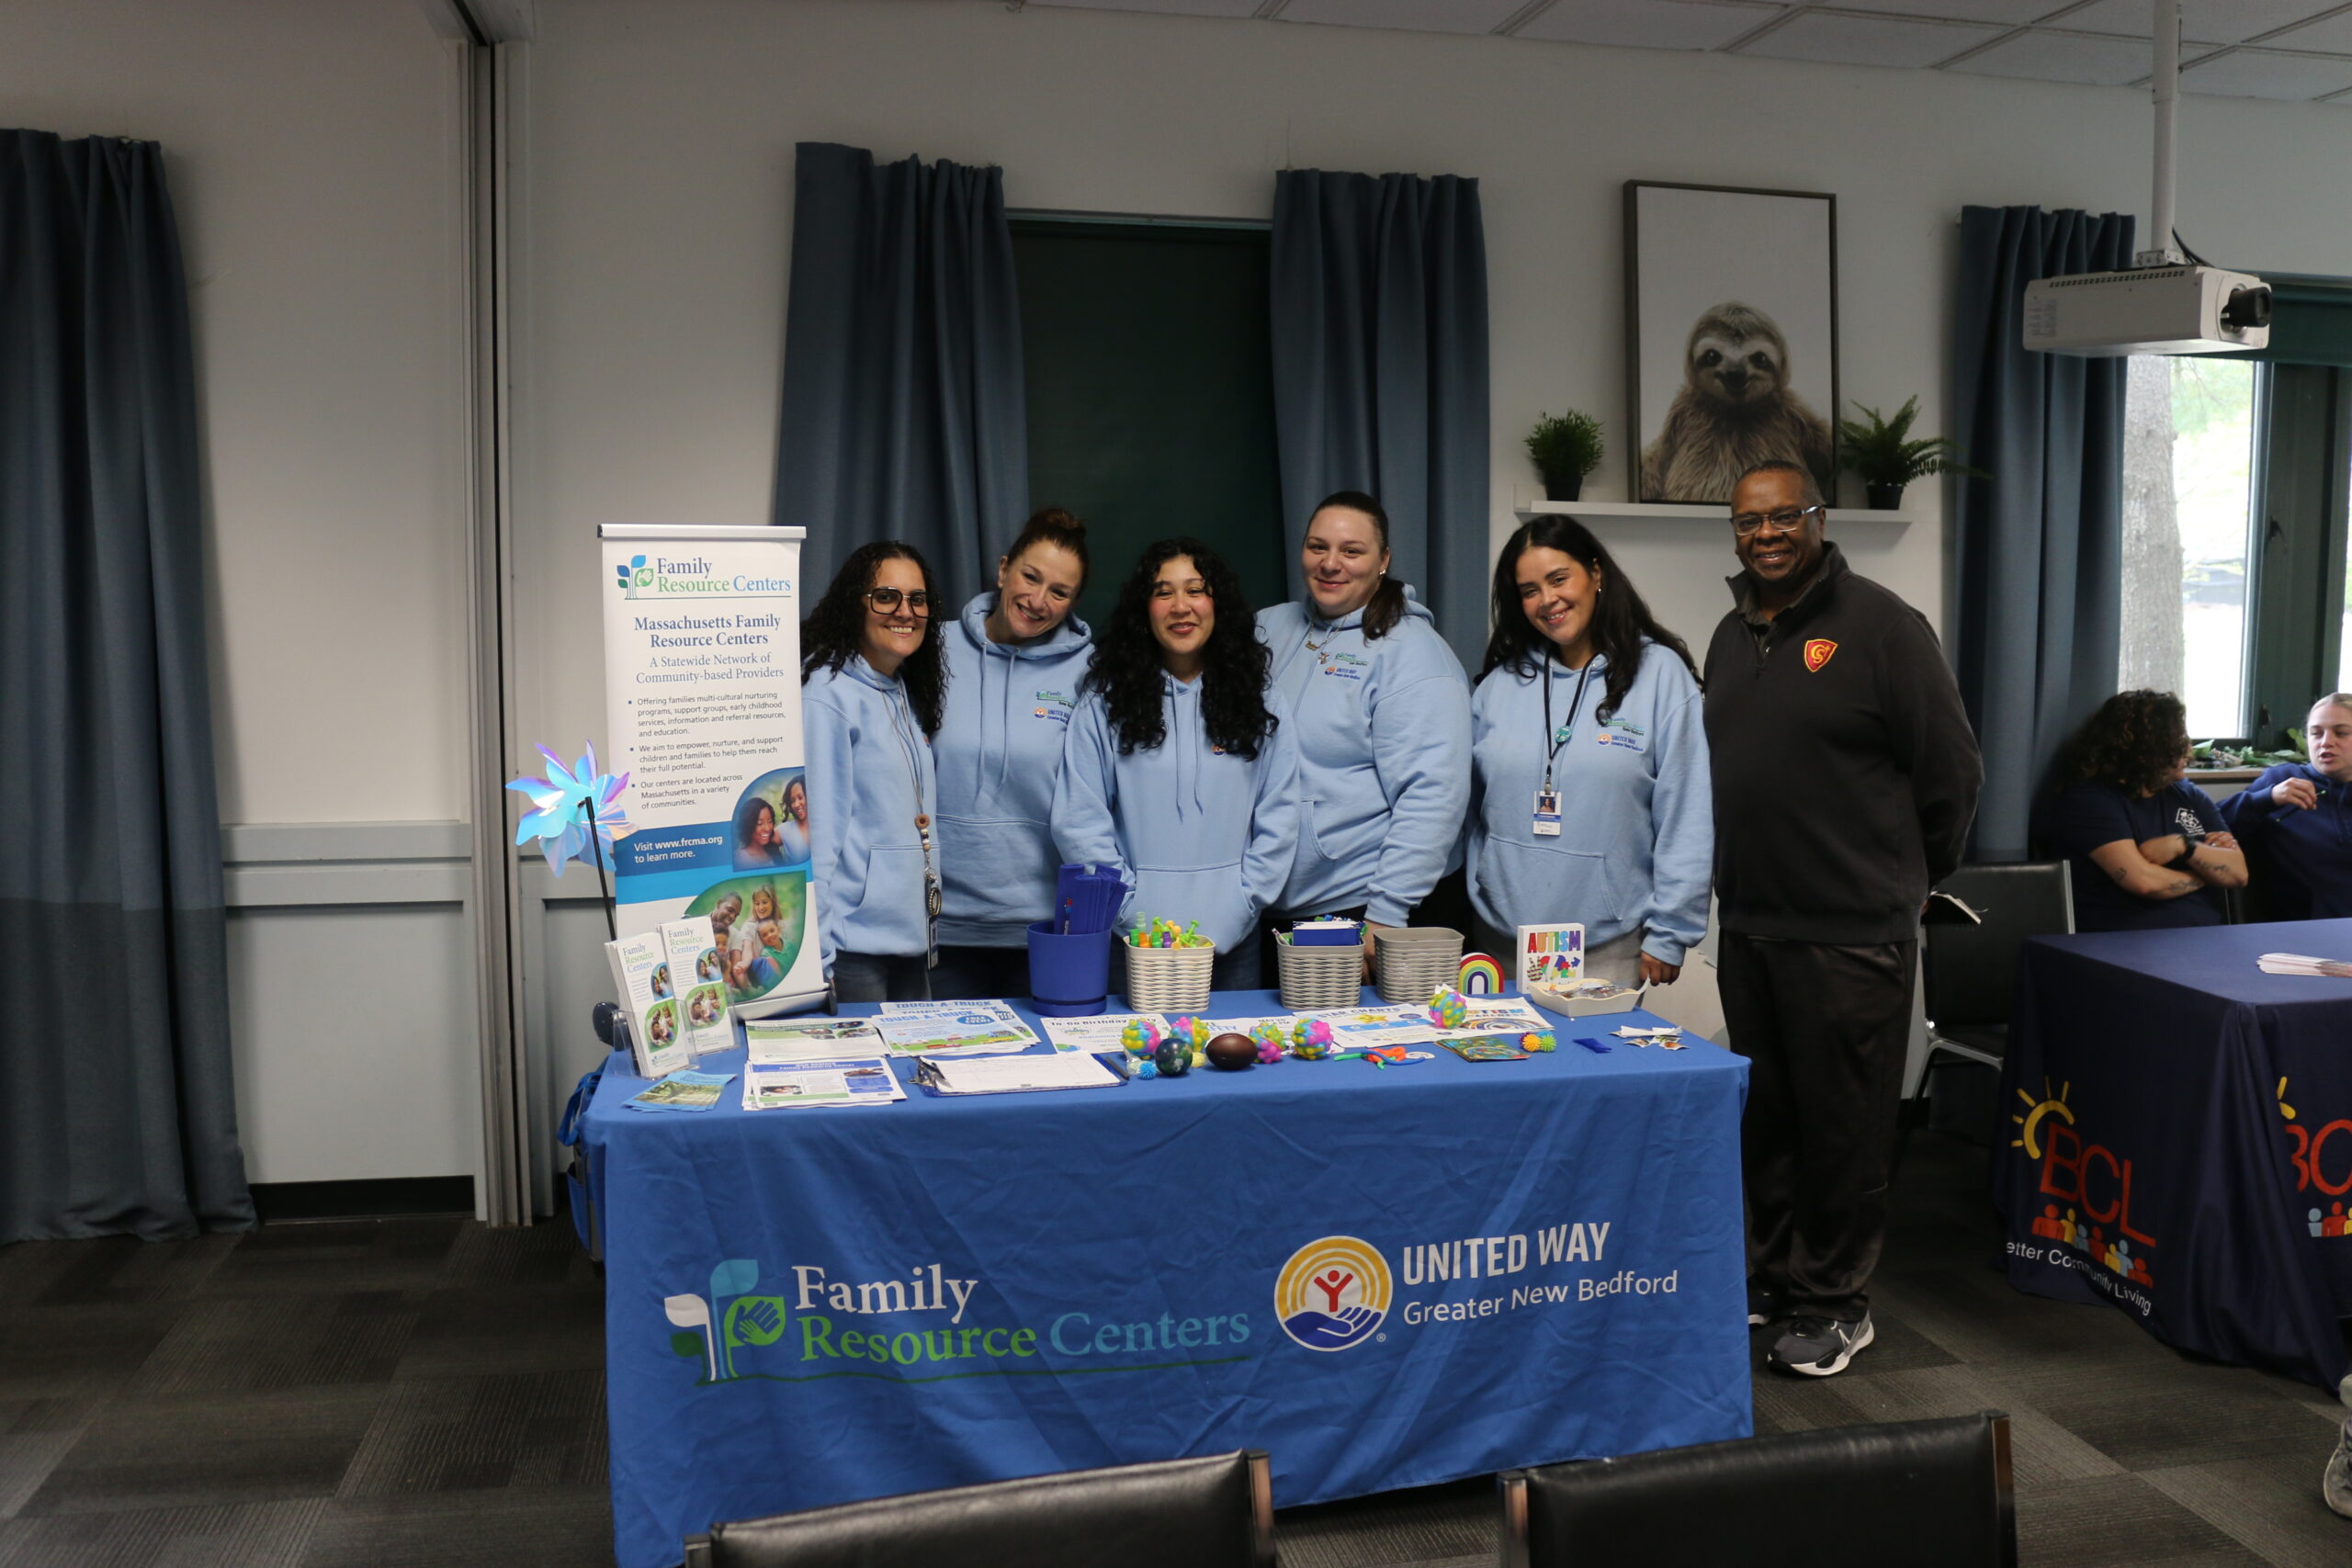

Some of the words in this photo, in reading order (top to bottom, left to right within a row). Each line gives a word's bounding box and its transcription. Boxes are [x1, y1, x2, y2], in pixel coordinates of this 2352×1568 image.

[657, 558, 712, 578] Family
[658, 577, 729, 592] Resource
[733, 576, 791, 592] Centers
[634, 615, 731, 630] Massachusetts
[736, 614, 781, 630] Family
[650, 635, 712, 648] Resource
[717, 632, 768, 646] Centers
[650, 657, 658, 668] A
[661, 655, 710, 667] Statewide
[714, 653, 757, 665] Network
[761, 652, 772, 663] of
[636, 671, 733, 683] Community-based
[736, 668, 784, 680] Providers
[638, 697, 666, 705] Offering
[697, 694, 742, 703] multi-cultural
[638, 708, 672, 717] programs,
[674, 706, 701, 715] support
[703, 705, 728, 714] groups,
[639, 718, 666, 727] services,
[668, 716, 709, 725] information
[653, 728, 690, 736] education.
[676, 741, 711, 750] empower,
[741, 737, 754, 745] and
[757, 736, 783, 745] support
[639, 754, 667, 762] children
[670, 752, 682, 761] and
[684, 750, 711, 759] families
[722, 749, 737, 758] help
[759, 746, 777, 754] reach
[640, 765, 656, 773] their
[672, 761, 706, 772] potential.
[641, 781, 654, 789] Our
[656, 778, 680, 787] centers
[682, 777, 694, 785] are
[695, 774, 721, 784] located
[723, 773, 742, 782] across
[641, 788, 690, 799] Massachusetts
[692, 786, 698, 795] in
[707, 785, 729, 795] variety
[642, 801, 649, 809] of
[650, 798, 696, 808] communities.
[634, 841, 653, 852] Visit
[655, 836, 723, 850] www.frcma.org
[635, 854, 644, 863] to
[647, 851, 668, 863] learn
[670, 849, 695, 859] more.
[668, 928, 694, 938] Family
[623, 943, 646, 955] Family
[670, 937, 704, 946] Resource
[1527, 931, 1580, 953] AUTISM
[671, 945, 700, 954] Centers
[628, 962, 652, 973] Centers
[2039, 1121, 2156, 1248] BCL
[1403, 1234, 1527, 1286] UNITED
[1538, 1222, 1611, 1266] WAY
[2007, 1242, 2043, 1260] etter
[2115, 1283, 2152, 1316] Living
[792, 1264, 978, 1324] Family
[1404, 1294, 1503, 1325] Greater
[1510, 1284, 1568, 1311] New
[1578, 1269, 1679, 1301] Bedford
[796, 1315, 1037, 1365] Resource
[1050, 1309, 1251, 1356] Centers
